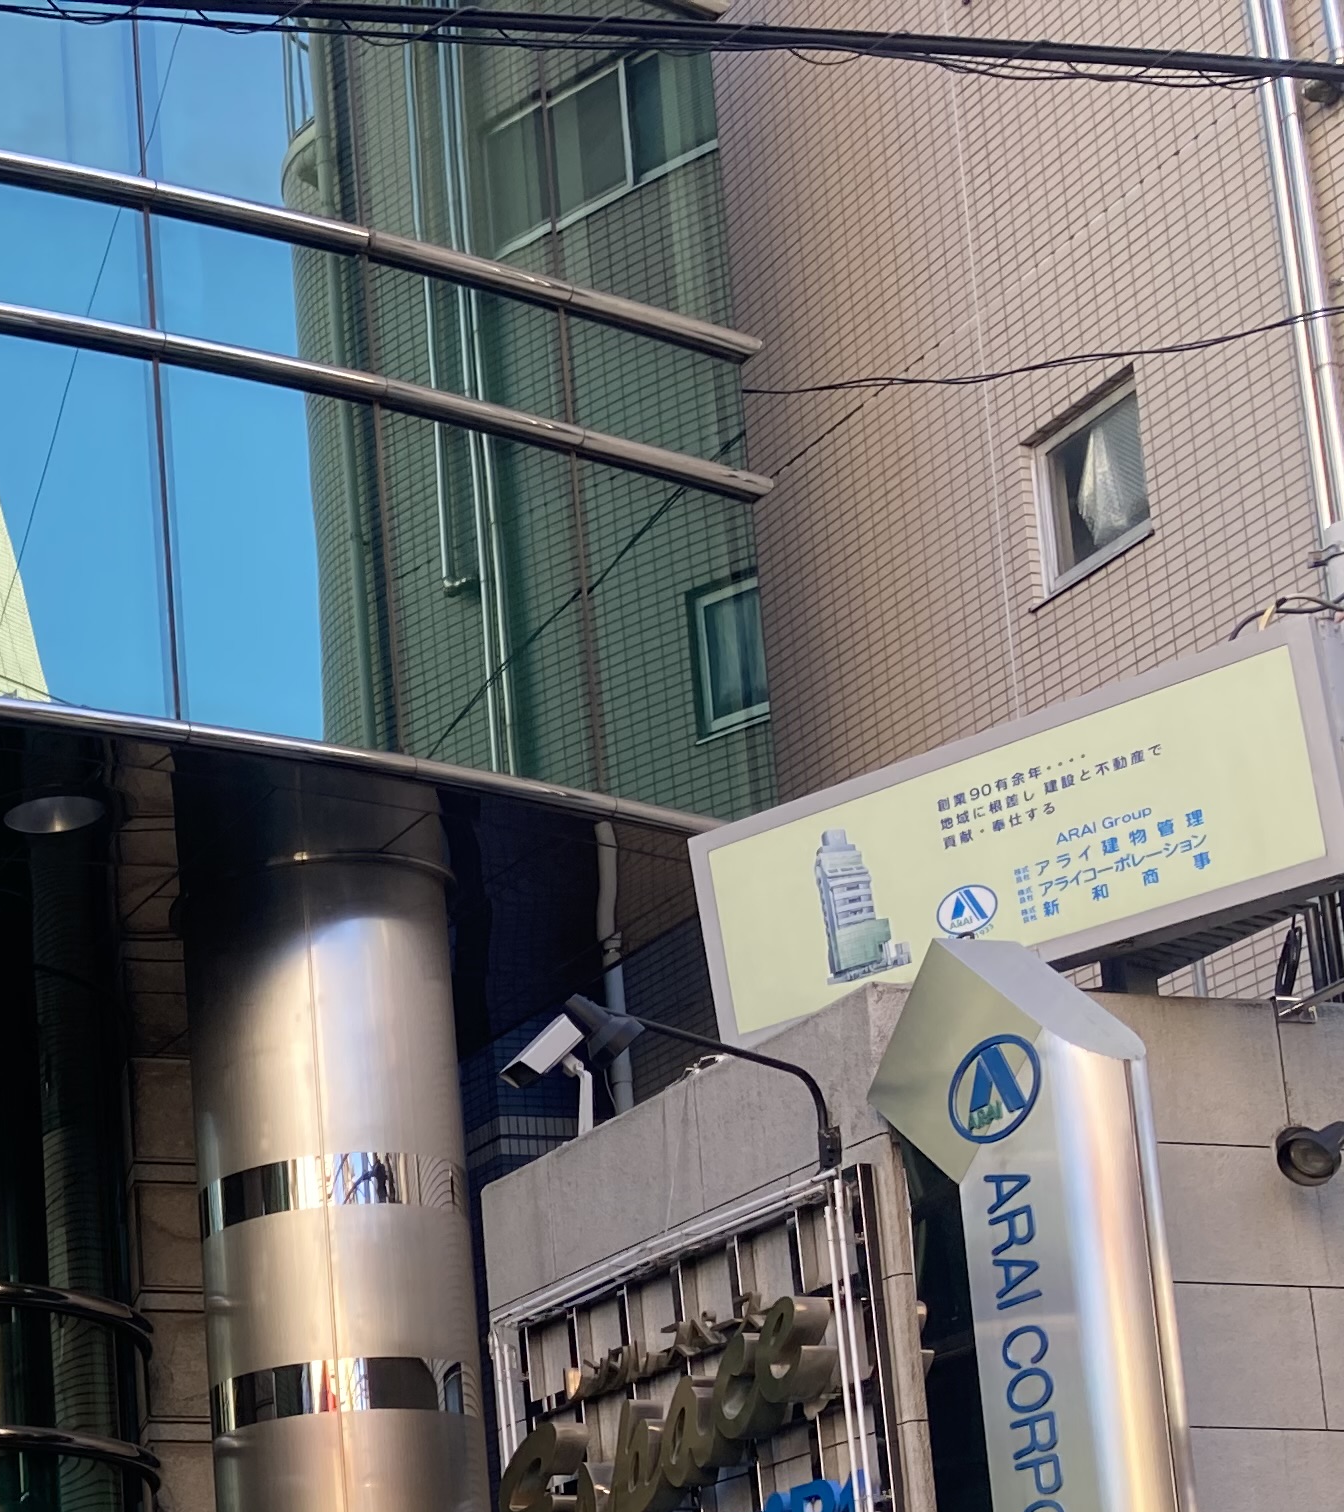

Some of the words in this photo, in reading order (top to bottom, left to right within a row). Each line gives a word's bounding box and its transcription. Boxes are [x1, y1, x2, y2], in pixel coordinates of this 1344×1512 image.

[1056, 822, 1097, 845] ARAI
[1102, 807, 1152, 830] Group
[1039, 834, 1207, 897] アライコーポレーション
[983, 1173, 1043, 1311] ARAI
